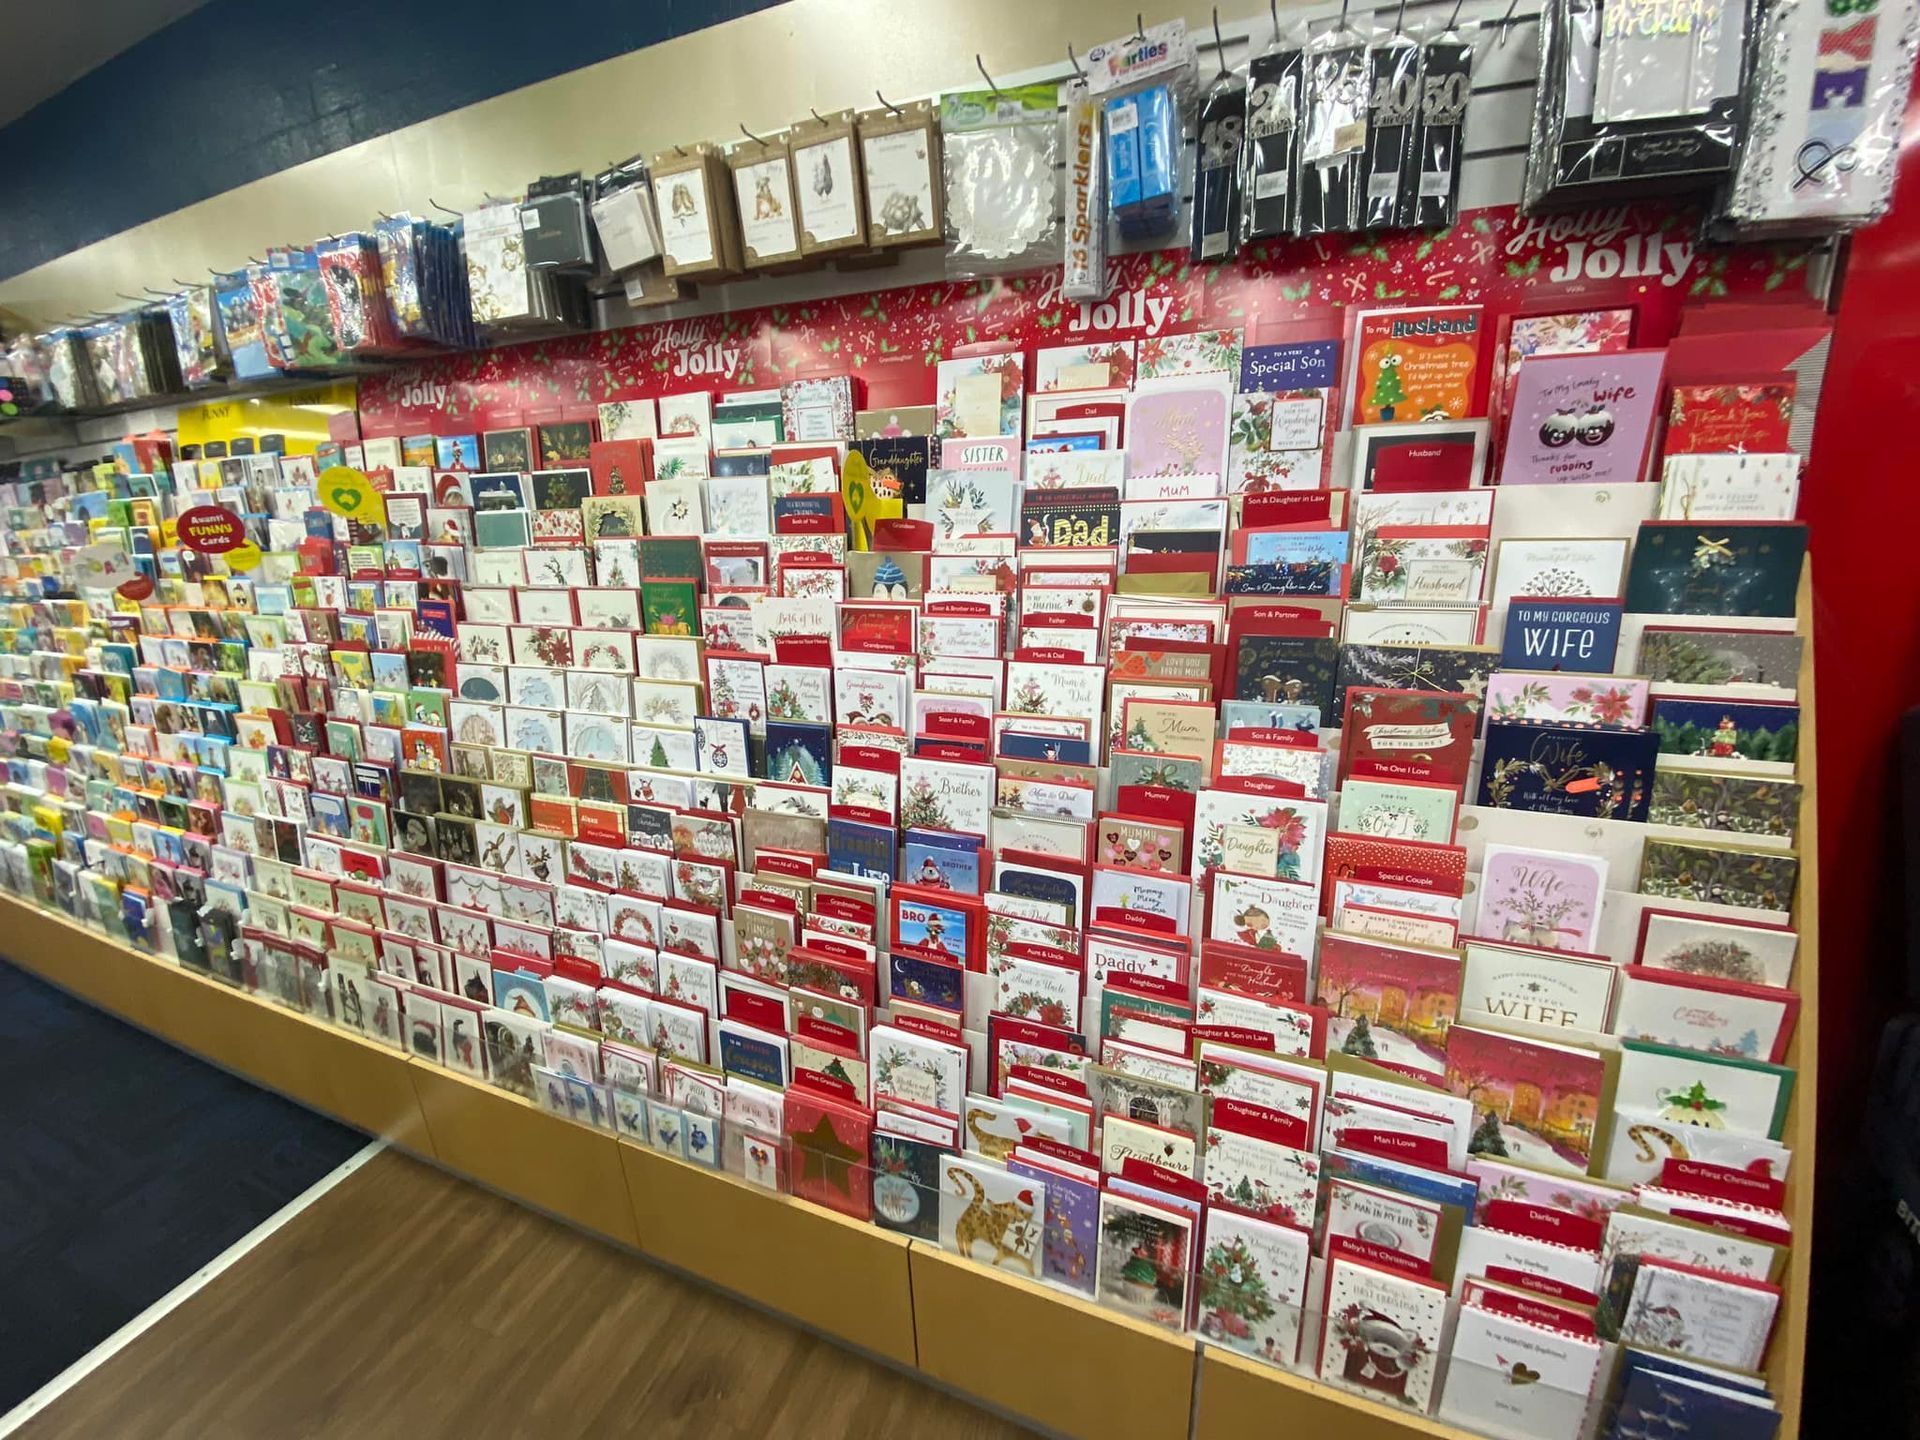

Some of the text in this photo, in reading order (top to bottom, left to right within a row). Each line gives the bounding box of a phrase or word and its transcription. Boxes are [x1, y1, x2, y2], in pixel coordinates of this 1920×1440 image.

[1422, 71, 1471, 116] 50
[1071, 122, 1092, 245] Sparklers
[1506, 205, 1630, 254] Holly
[1550, 235, 1695, 288] Jolly
[1068, 288, 1174, 336] Jolly
[1366, 312, 1478, 340] To my Husband
[652, 323, 707, 357] Holly
[1064, 335, 1085, 344] Mother
[674, 347, 741, 378] Jolly
[1249, 355, 1326, 377] Special Son
[1403, 360, 1470, 372] Christmas tree
[401, 383, 448, 410] Jolly
[1593, 386, 1636, 404] wife
[202, 406, 231, 420] FUNNY
[1084, 407, 1098, 415] Dad
[869, 449, 925, 471] Granddaughter
[962, 445, 1005, 464] SISTER
[1408, 449, 1442, 458] Husband
[1269, 495, 1301, 505] Daughter
[1311, 494, 1325, 502] Law
[191, 514, 225, 525] Avanti
[188, 525, 233, 537] FUNNY
[1053, 514, 1109, 547] Dad
[200, 536, 231, 546] Cards
[1253, 610, 1266, 618] Son
[1274, 611, 1300, 620] Partner
[1518, 610, 1531, 622] TO
[1032, 651, 1046, 659] Mum
[1053, 652, 1065, 660] Dad
[1166, 656, 1184, 667] LOVE
[1185, 667, 1207, 678] MUCH
[959, 718, 976, 727] Family
[1159, 718, 1201, 735] Mum
[1251, 731, 1265, 740] Son
[1272, 732, 1296, 743] Family
[941, 749, 961, 757] Brother
[1530, 731, 1589, 767] Wife
[1374, 763, 1388, 772] The
[1389, 764, 1406, 774] One
[1411, 766, 1430, 776] Love
[937, 777, 983, 798] Brother
[1243, 780, 1276, 791] Daughter
[1144, 790, 1170, 801] Mummy
[1120, 826, 1157, 841] MUMMY
[1225, 836, 1276, 858] Daughter
[1378, 871, 1434, 886] Special Couple
[1511, 865, 1575, 897] Wife
[1260, 891, 1316, 912] Daughter
[901, 909, 926, 923] BRO
[1124, 913, 1147, 925] Daddy
[1026, 947, 1041, 956] Aunt
[1048, 951, 1065, 961] Uncle
[1094, 952, 1147, 975] Daddy
[1129, 977, 1166, 991] Neighbours
[1020, 1027, 1039, 1038] Aunty
[1191, 1028, 1222, 1040] Daughter
[1230, 1033, 1244, 1042] Son
[1253, 1034, 1269, 1044] Law
[1027, 1070, 1068, 1087] From the Cat
[1412, 1072, 1428, 1082] Life
[1227, 1102, 1262, 1118] Daughter
[1269, 1113, 1294, 1128] Family
[1373, 1134, 1390, 1145] Man
[1395, 1137, 1417, 1149] Love
[1039, 1141, 1082, 1162] From the Dog
[1151, 1168, 1180, 1184] Teacher
[1678, 1164, 1771, 1191] Our First Christmas
[1529, 1210, 1561, 1227] Darling
[1342, 1239, 1366, 1254] Baby's
[1379, 1250, 1419, 1269] Christmas
[1521, 1277, 1563, 1295] Girlfriend
[1517, 1302, 1560, 1321] Boyfriend
